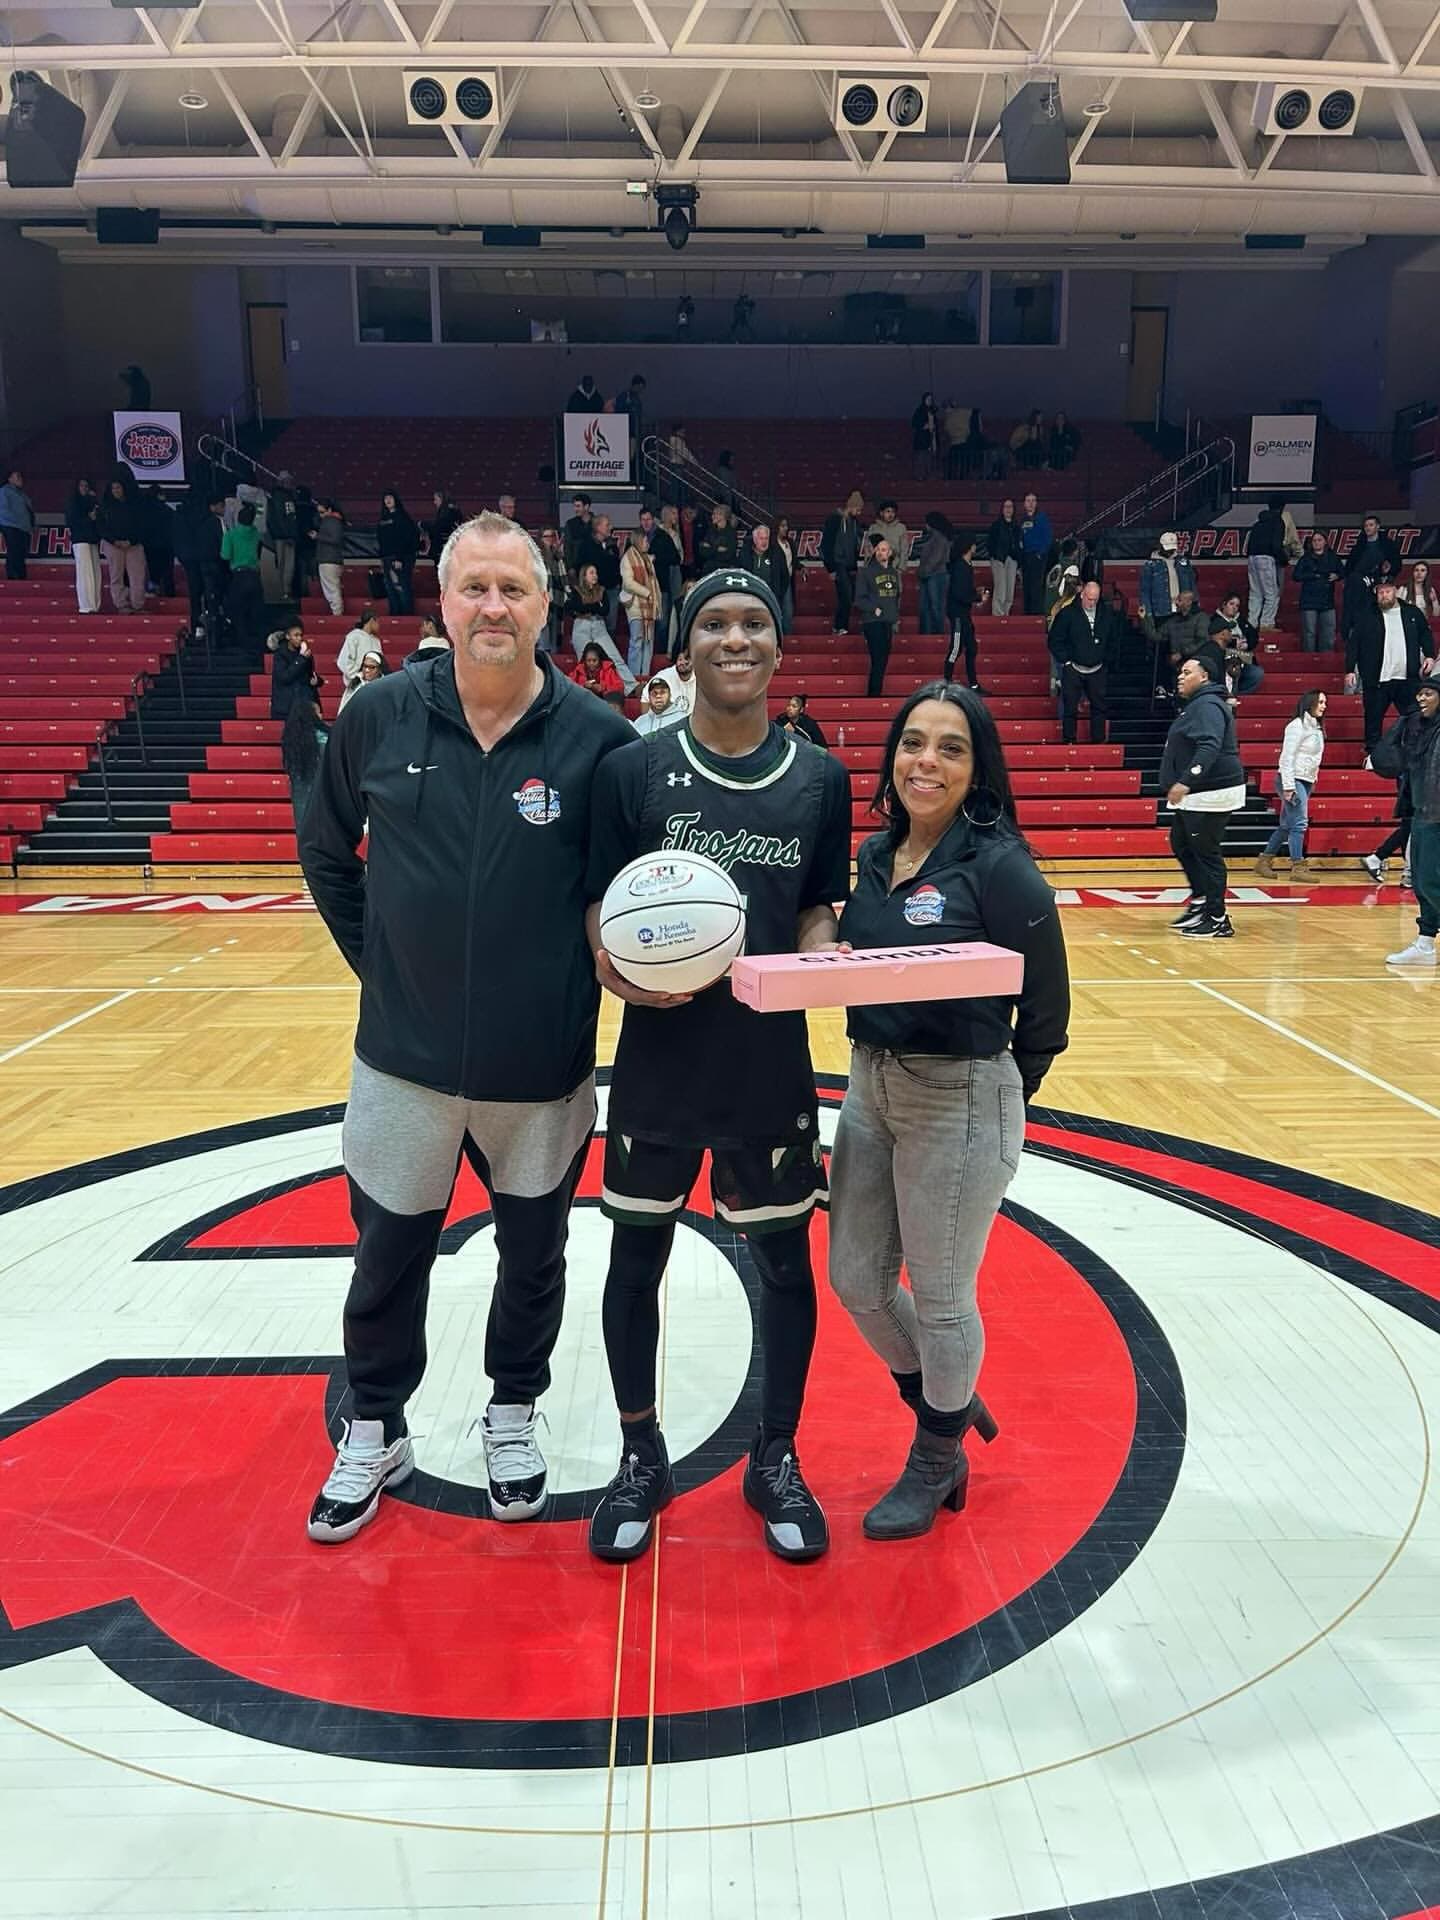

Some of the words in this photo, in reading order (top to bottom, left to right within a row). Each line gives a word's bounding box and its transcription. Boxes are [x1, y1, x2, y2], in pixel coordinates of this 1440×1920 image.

[127, 431, 172, 448] Jersey
[1268, 440, 1313, 449] PALMEN
[569, 460, 625, 470] CARTHAGE
[662, 812, 801, 873] Trojans
[658, 920, 689, 933] Honda
[664, 928, 697, 940] Kenosha
[798, 947, 961, 963] crumbl
